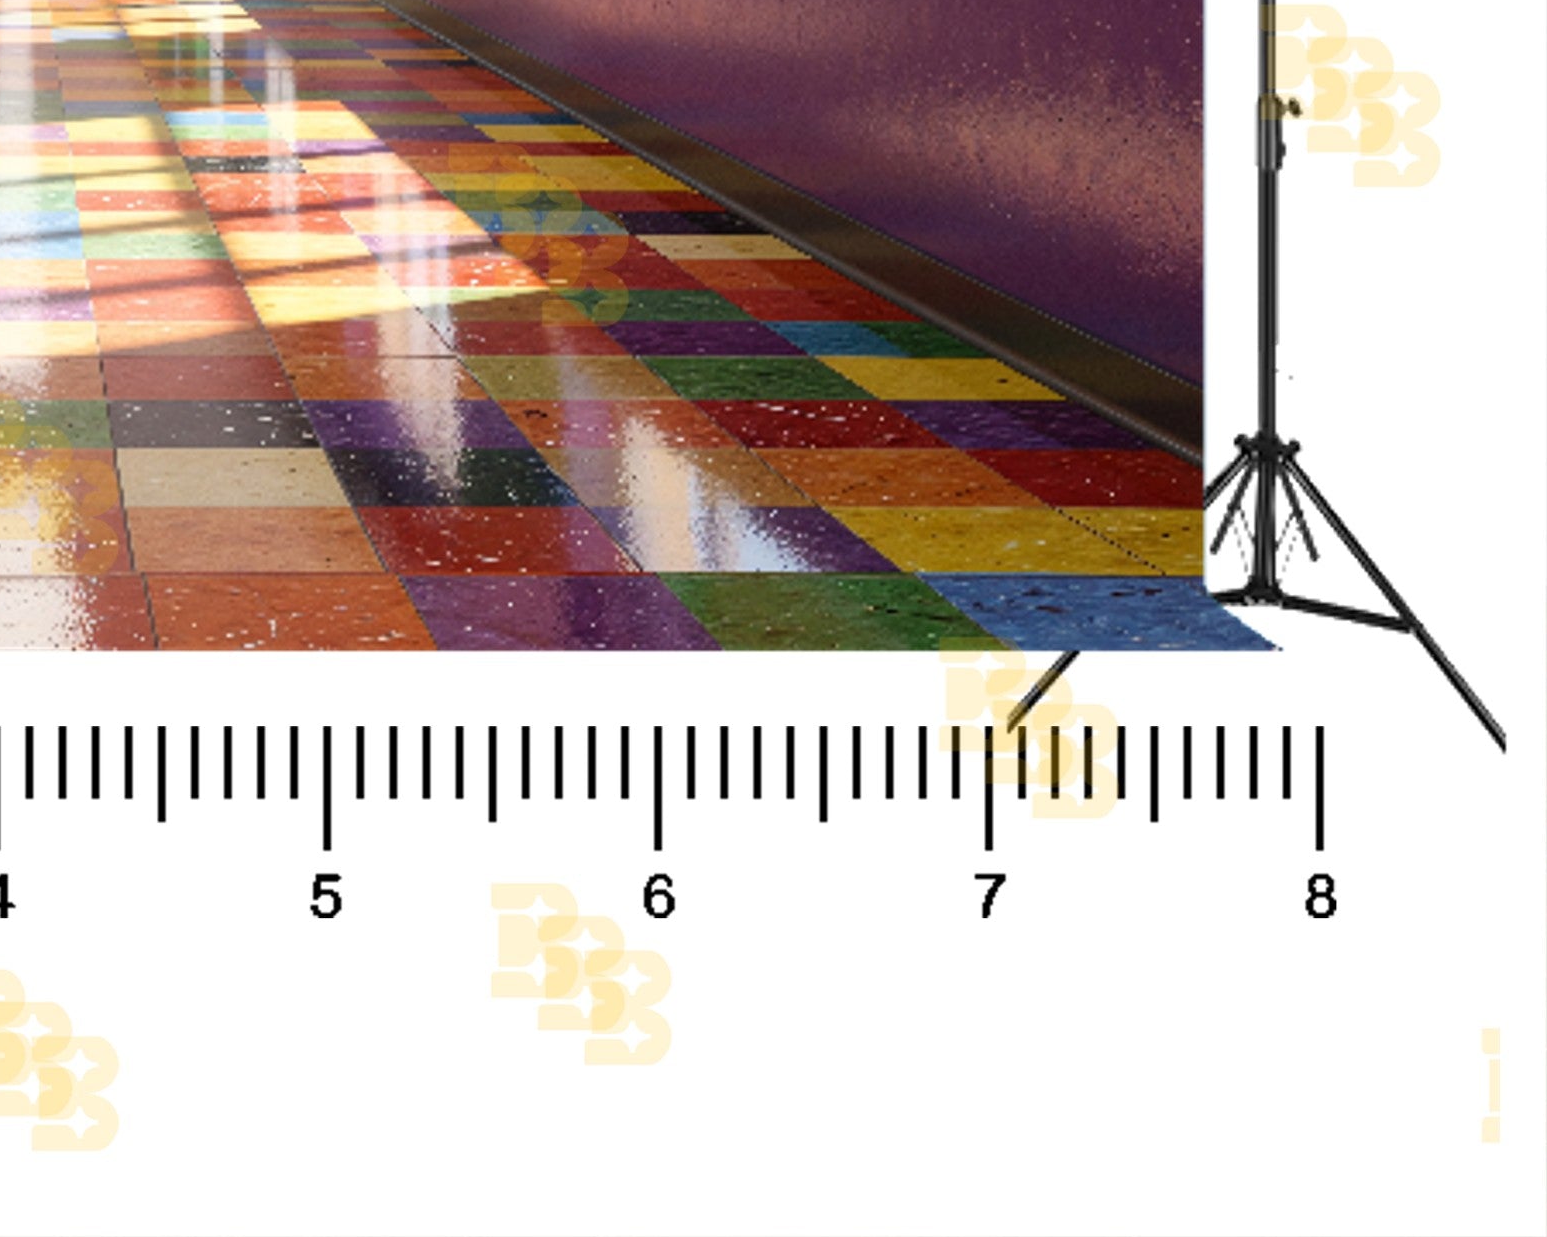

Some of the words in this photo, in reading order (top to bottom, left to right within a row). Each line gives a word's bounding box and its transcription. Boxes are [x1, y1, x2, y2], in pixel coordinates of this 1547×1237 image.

[310, 874, 342, 918] 5
[643, 874, 676, 918] 6
[974, 874, 1007, 918] 7
[1305, 874, 1337, 918] 8
